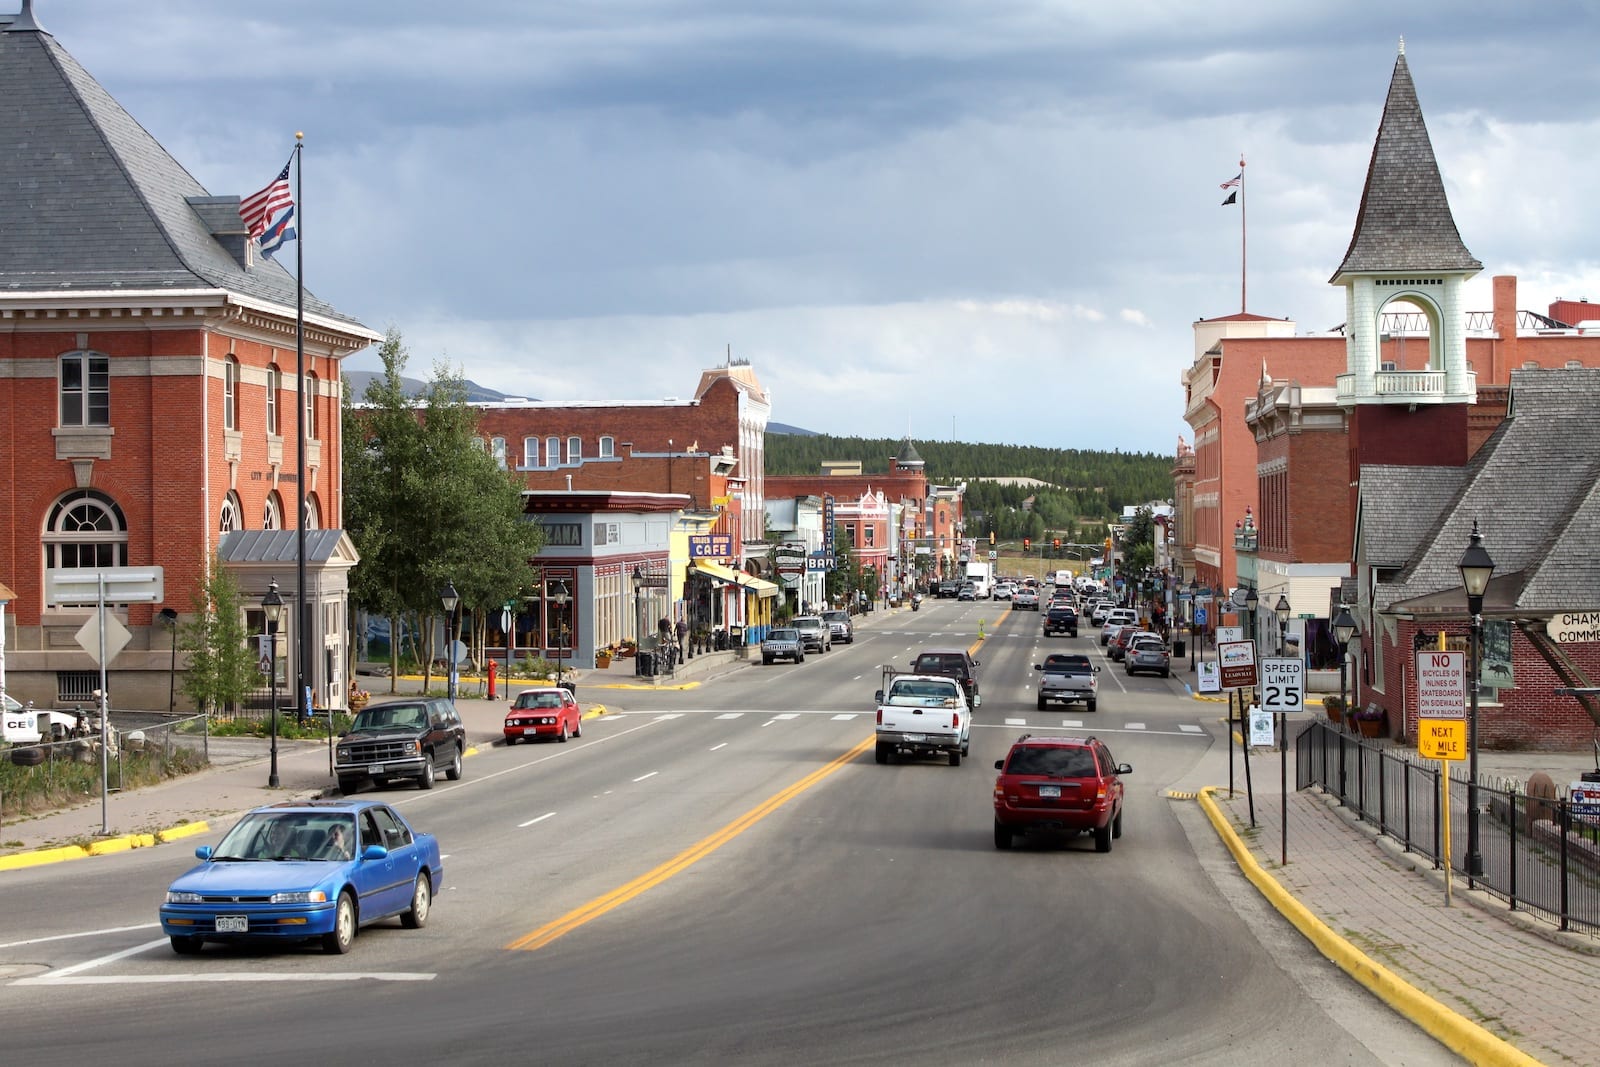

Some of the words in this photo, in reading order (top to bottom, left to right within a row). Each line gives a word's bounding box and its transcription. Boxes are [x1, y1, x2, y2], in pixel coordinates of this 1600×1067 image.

[825, 498, 833, 556] MANHATTAN
[695, 544, 727, 555] CAFE
[808, 558, 835, 569] BAR
[1562, 613, 1600, 625] CHAM
[1431, 654, 1450, 668] NO
[1264, 664, 1300, 673] SPEED
[1268, 675, 1296, 684] LIMIT
[1265, 686, 1299, 706] 25
[1420, 689, 1462, 697] SKATEBOARDS
[1420, 699, 1430, 707] ON
[1430, 699, 1463, 707] SIDEWALKS
[1431, 727, 1454, 737] NEXT
[1437, 740, 1457, 752] MILE
